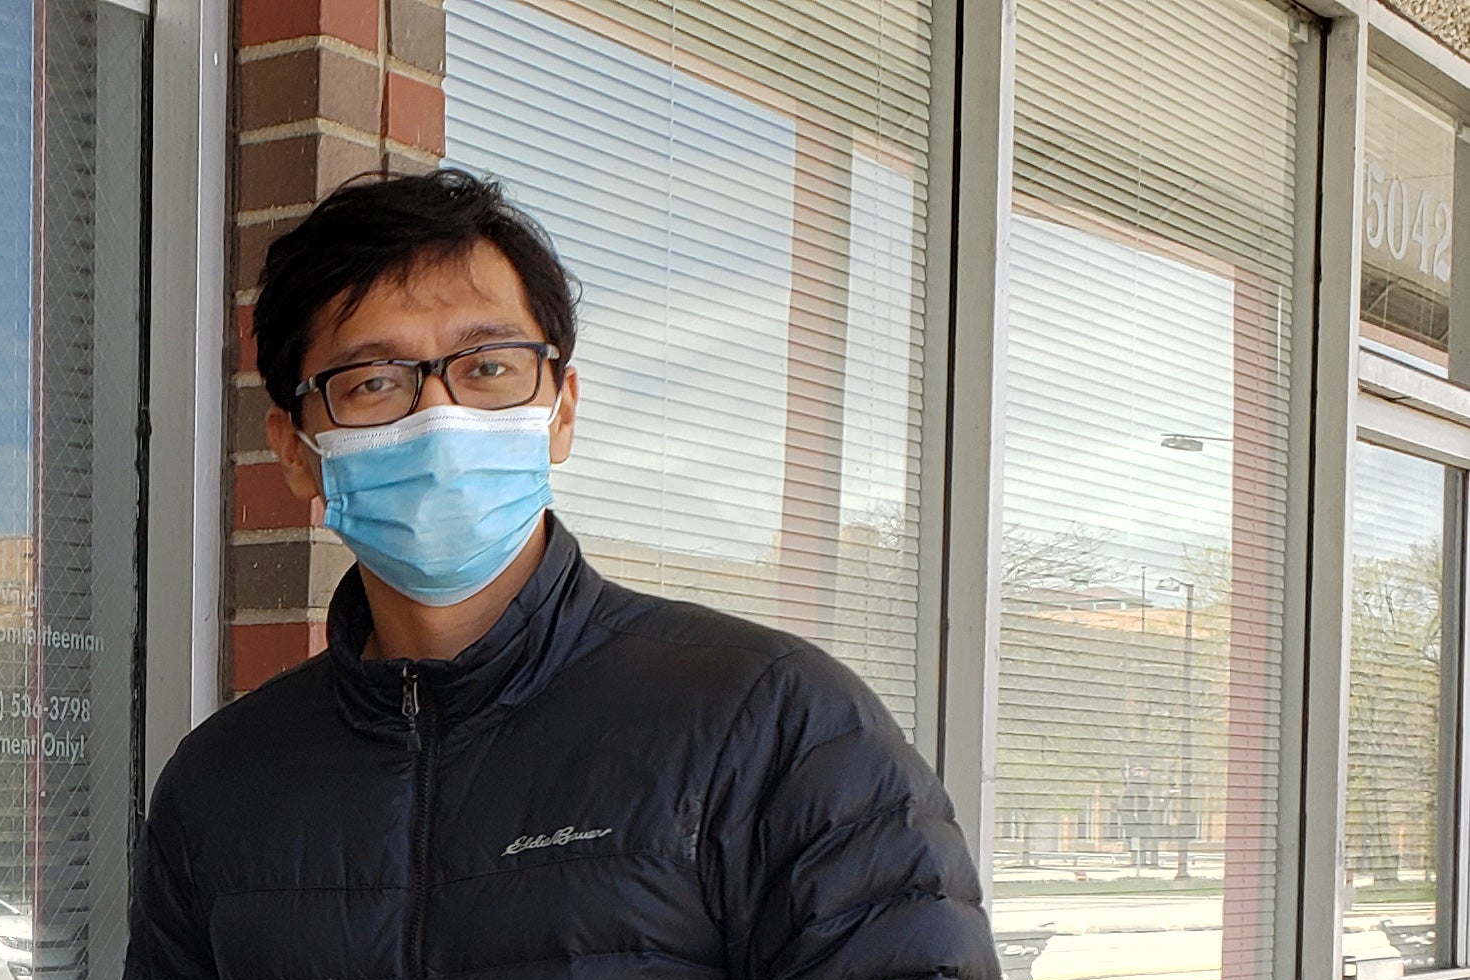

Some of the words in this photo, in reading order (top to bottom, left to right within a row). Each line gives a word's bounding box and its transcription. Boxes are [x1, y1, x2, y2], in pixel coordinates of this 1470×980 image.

[1366, 161, 1451, 282] 5042
[11, 692, 90, 723] 536-3798
[42, 731, 84, 765] Only!
[501, 835, 556, 856] Eddie
[553, 826, 612, 846] Bauer
